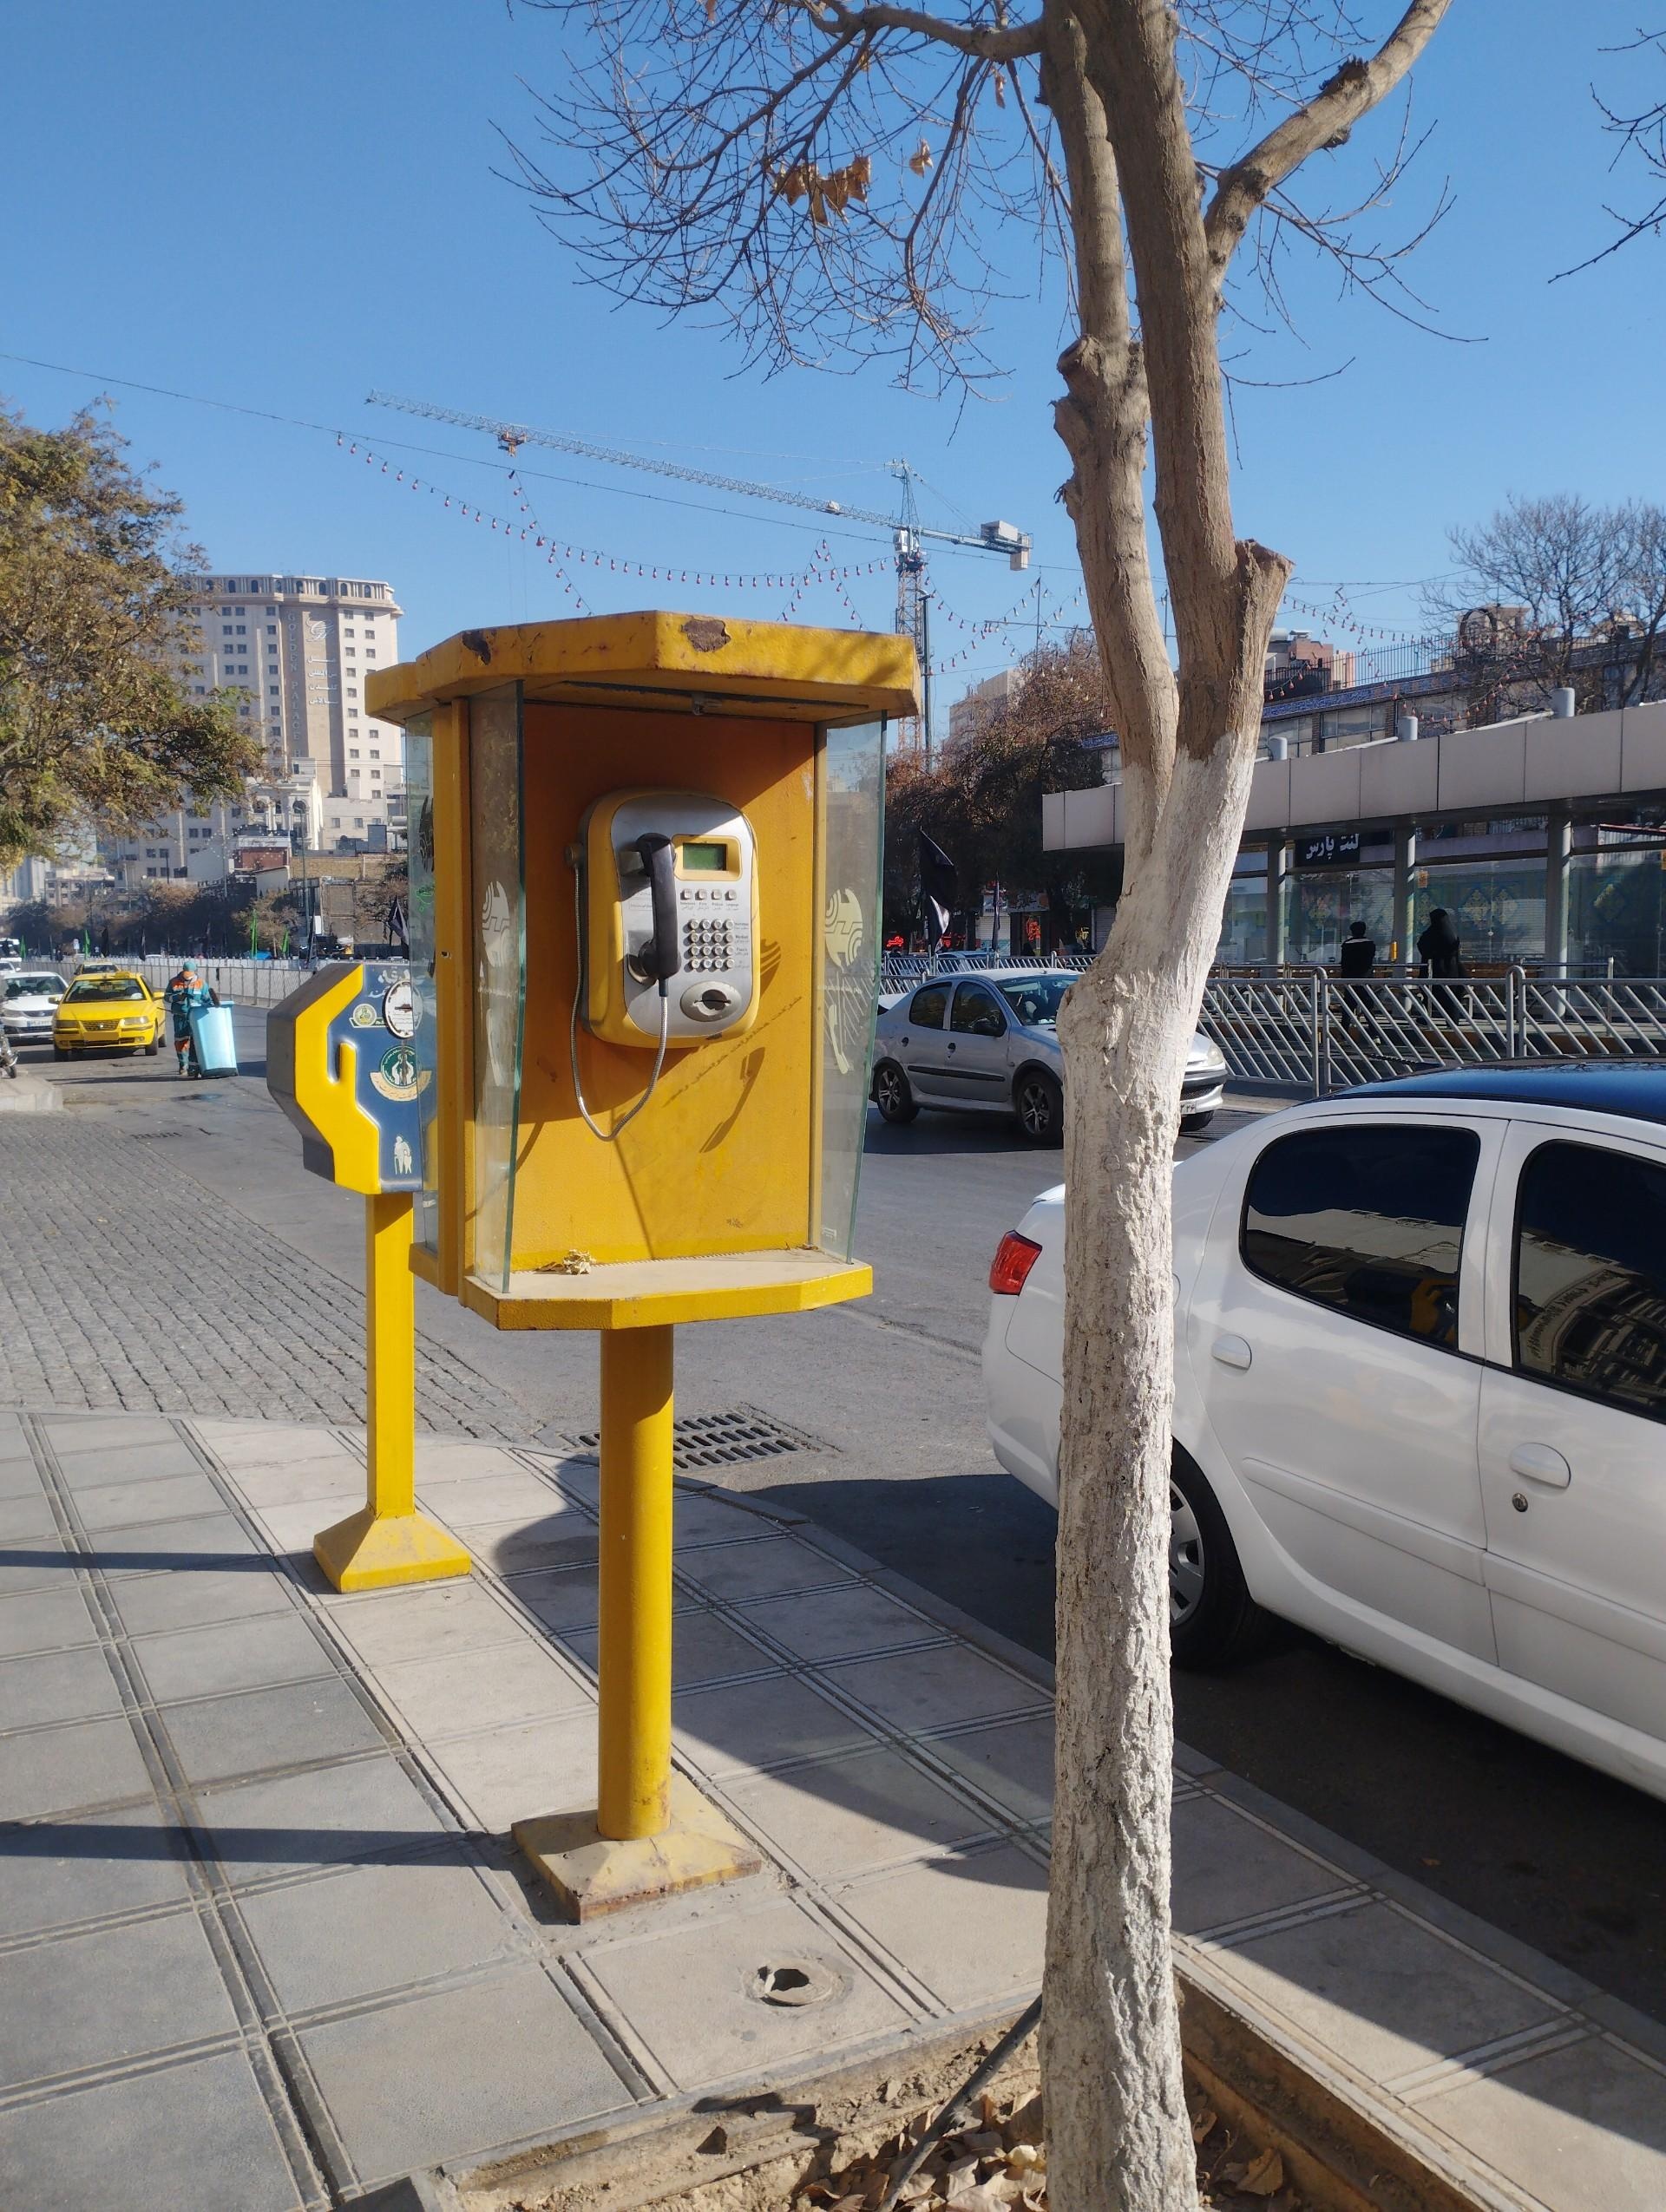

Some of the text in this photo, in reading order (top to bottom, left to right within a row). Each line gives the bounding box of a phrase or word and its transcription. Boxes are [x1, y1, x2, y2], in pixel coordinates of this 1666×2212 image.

[287, 612, 298, 672] GOLDEN
[292, 681, 300, 740] PALACE
[1306, 833, 1360, 860] لنت پارس
